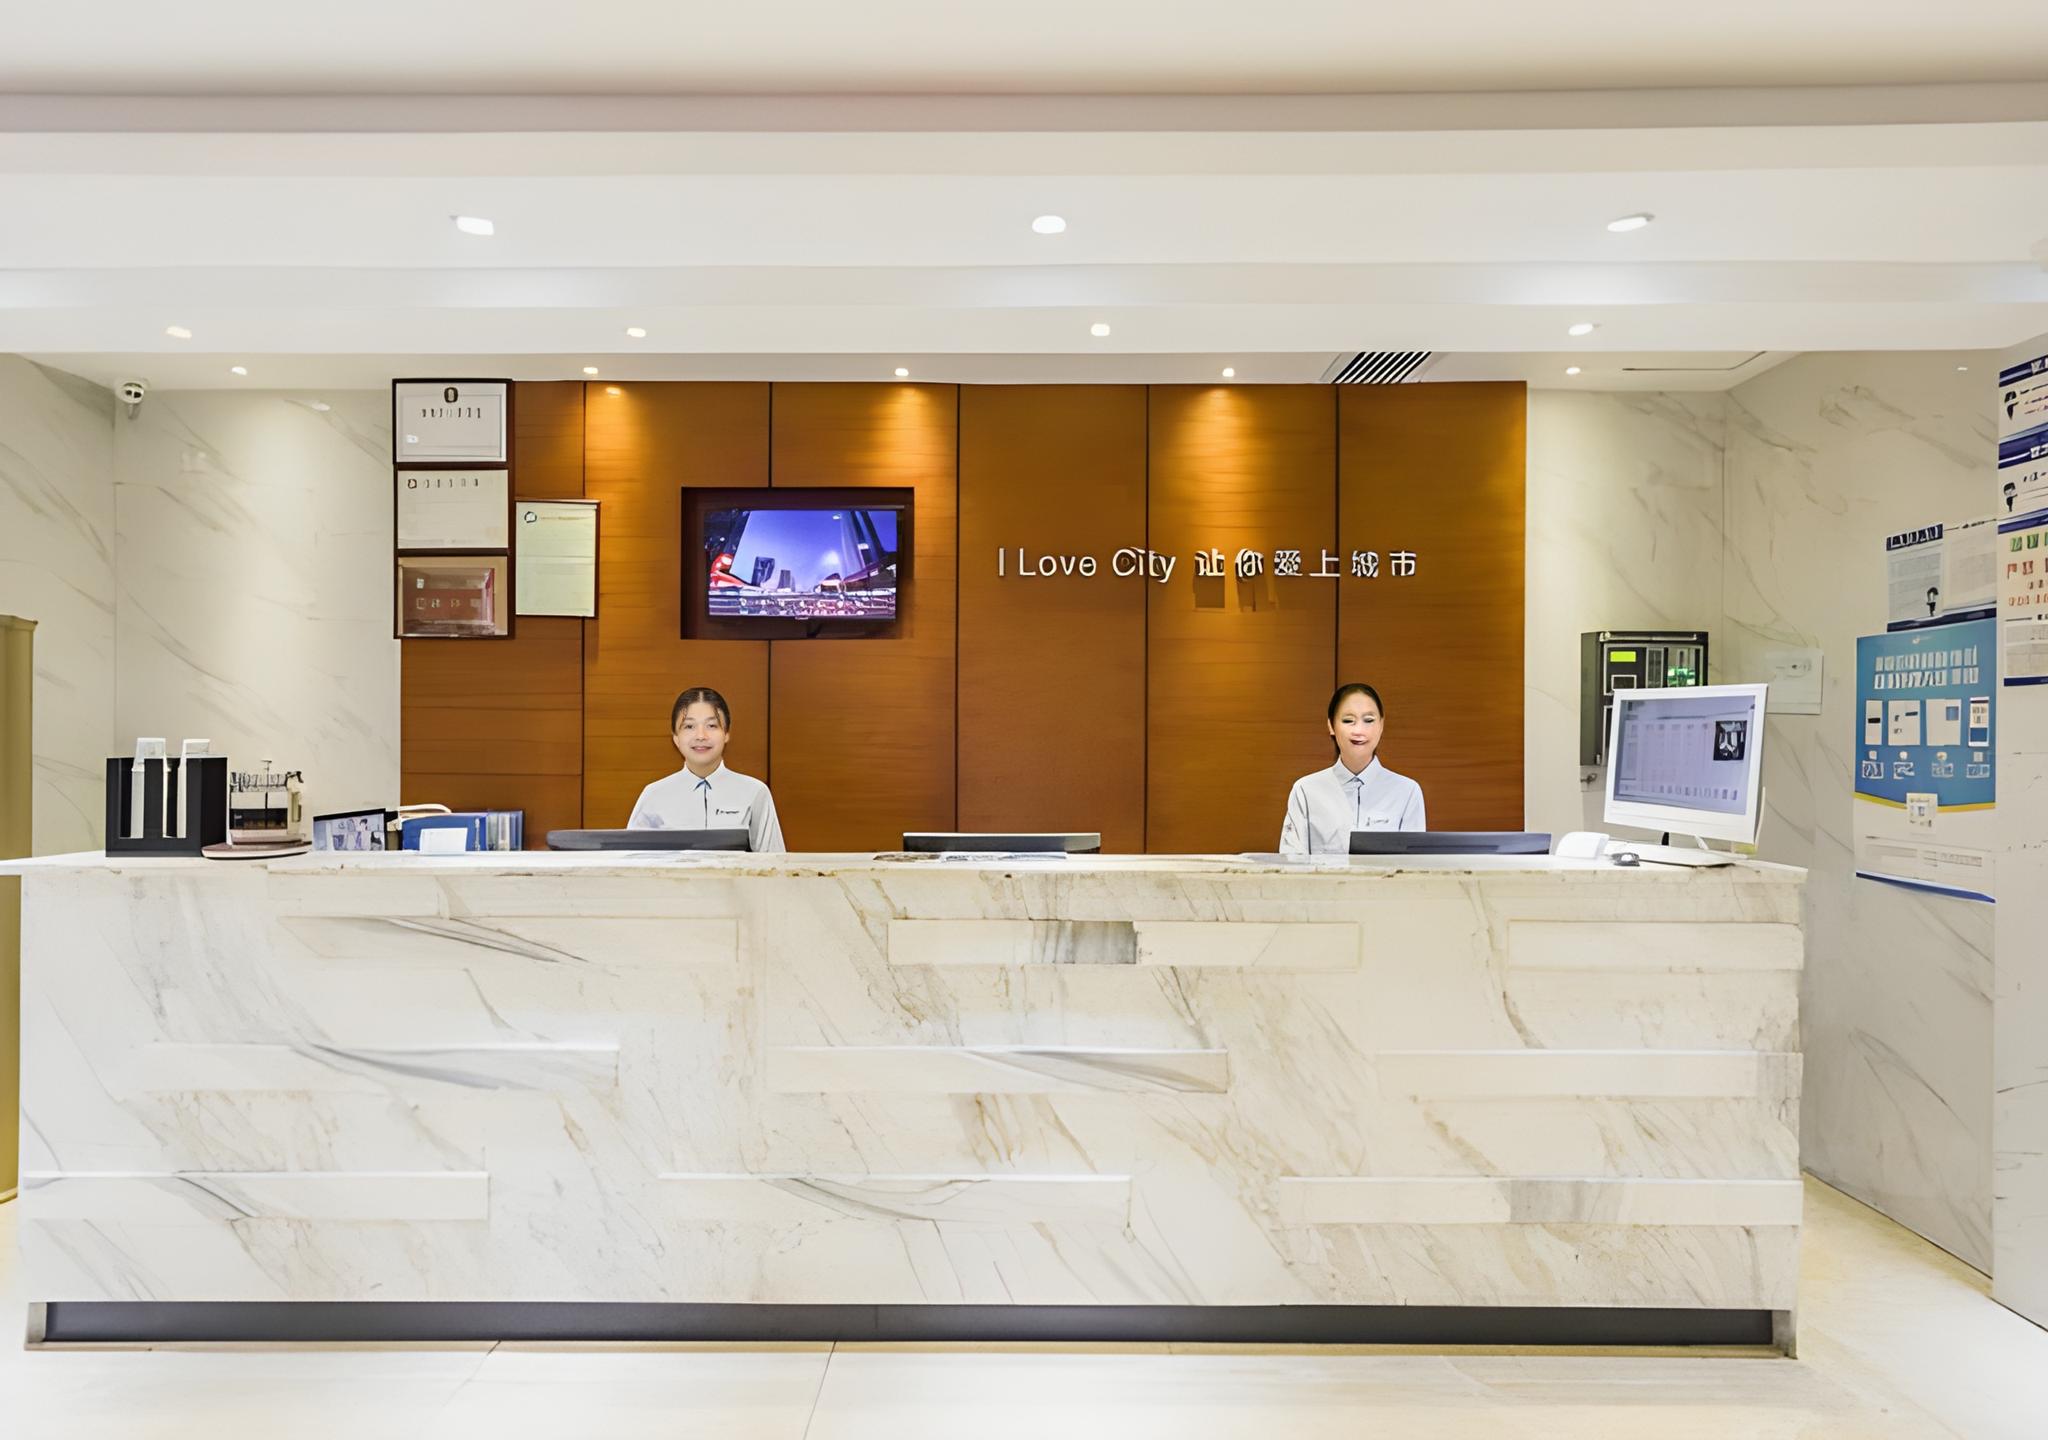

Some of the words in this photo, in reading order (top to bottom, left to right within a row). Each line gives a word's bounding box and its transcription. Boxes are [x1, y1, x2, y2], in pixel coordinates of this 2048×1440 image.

[998, 547, 1005, 577] I
[1018, 547, 1097, 577] Love
[1112, 546, 1177, 583] City
